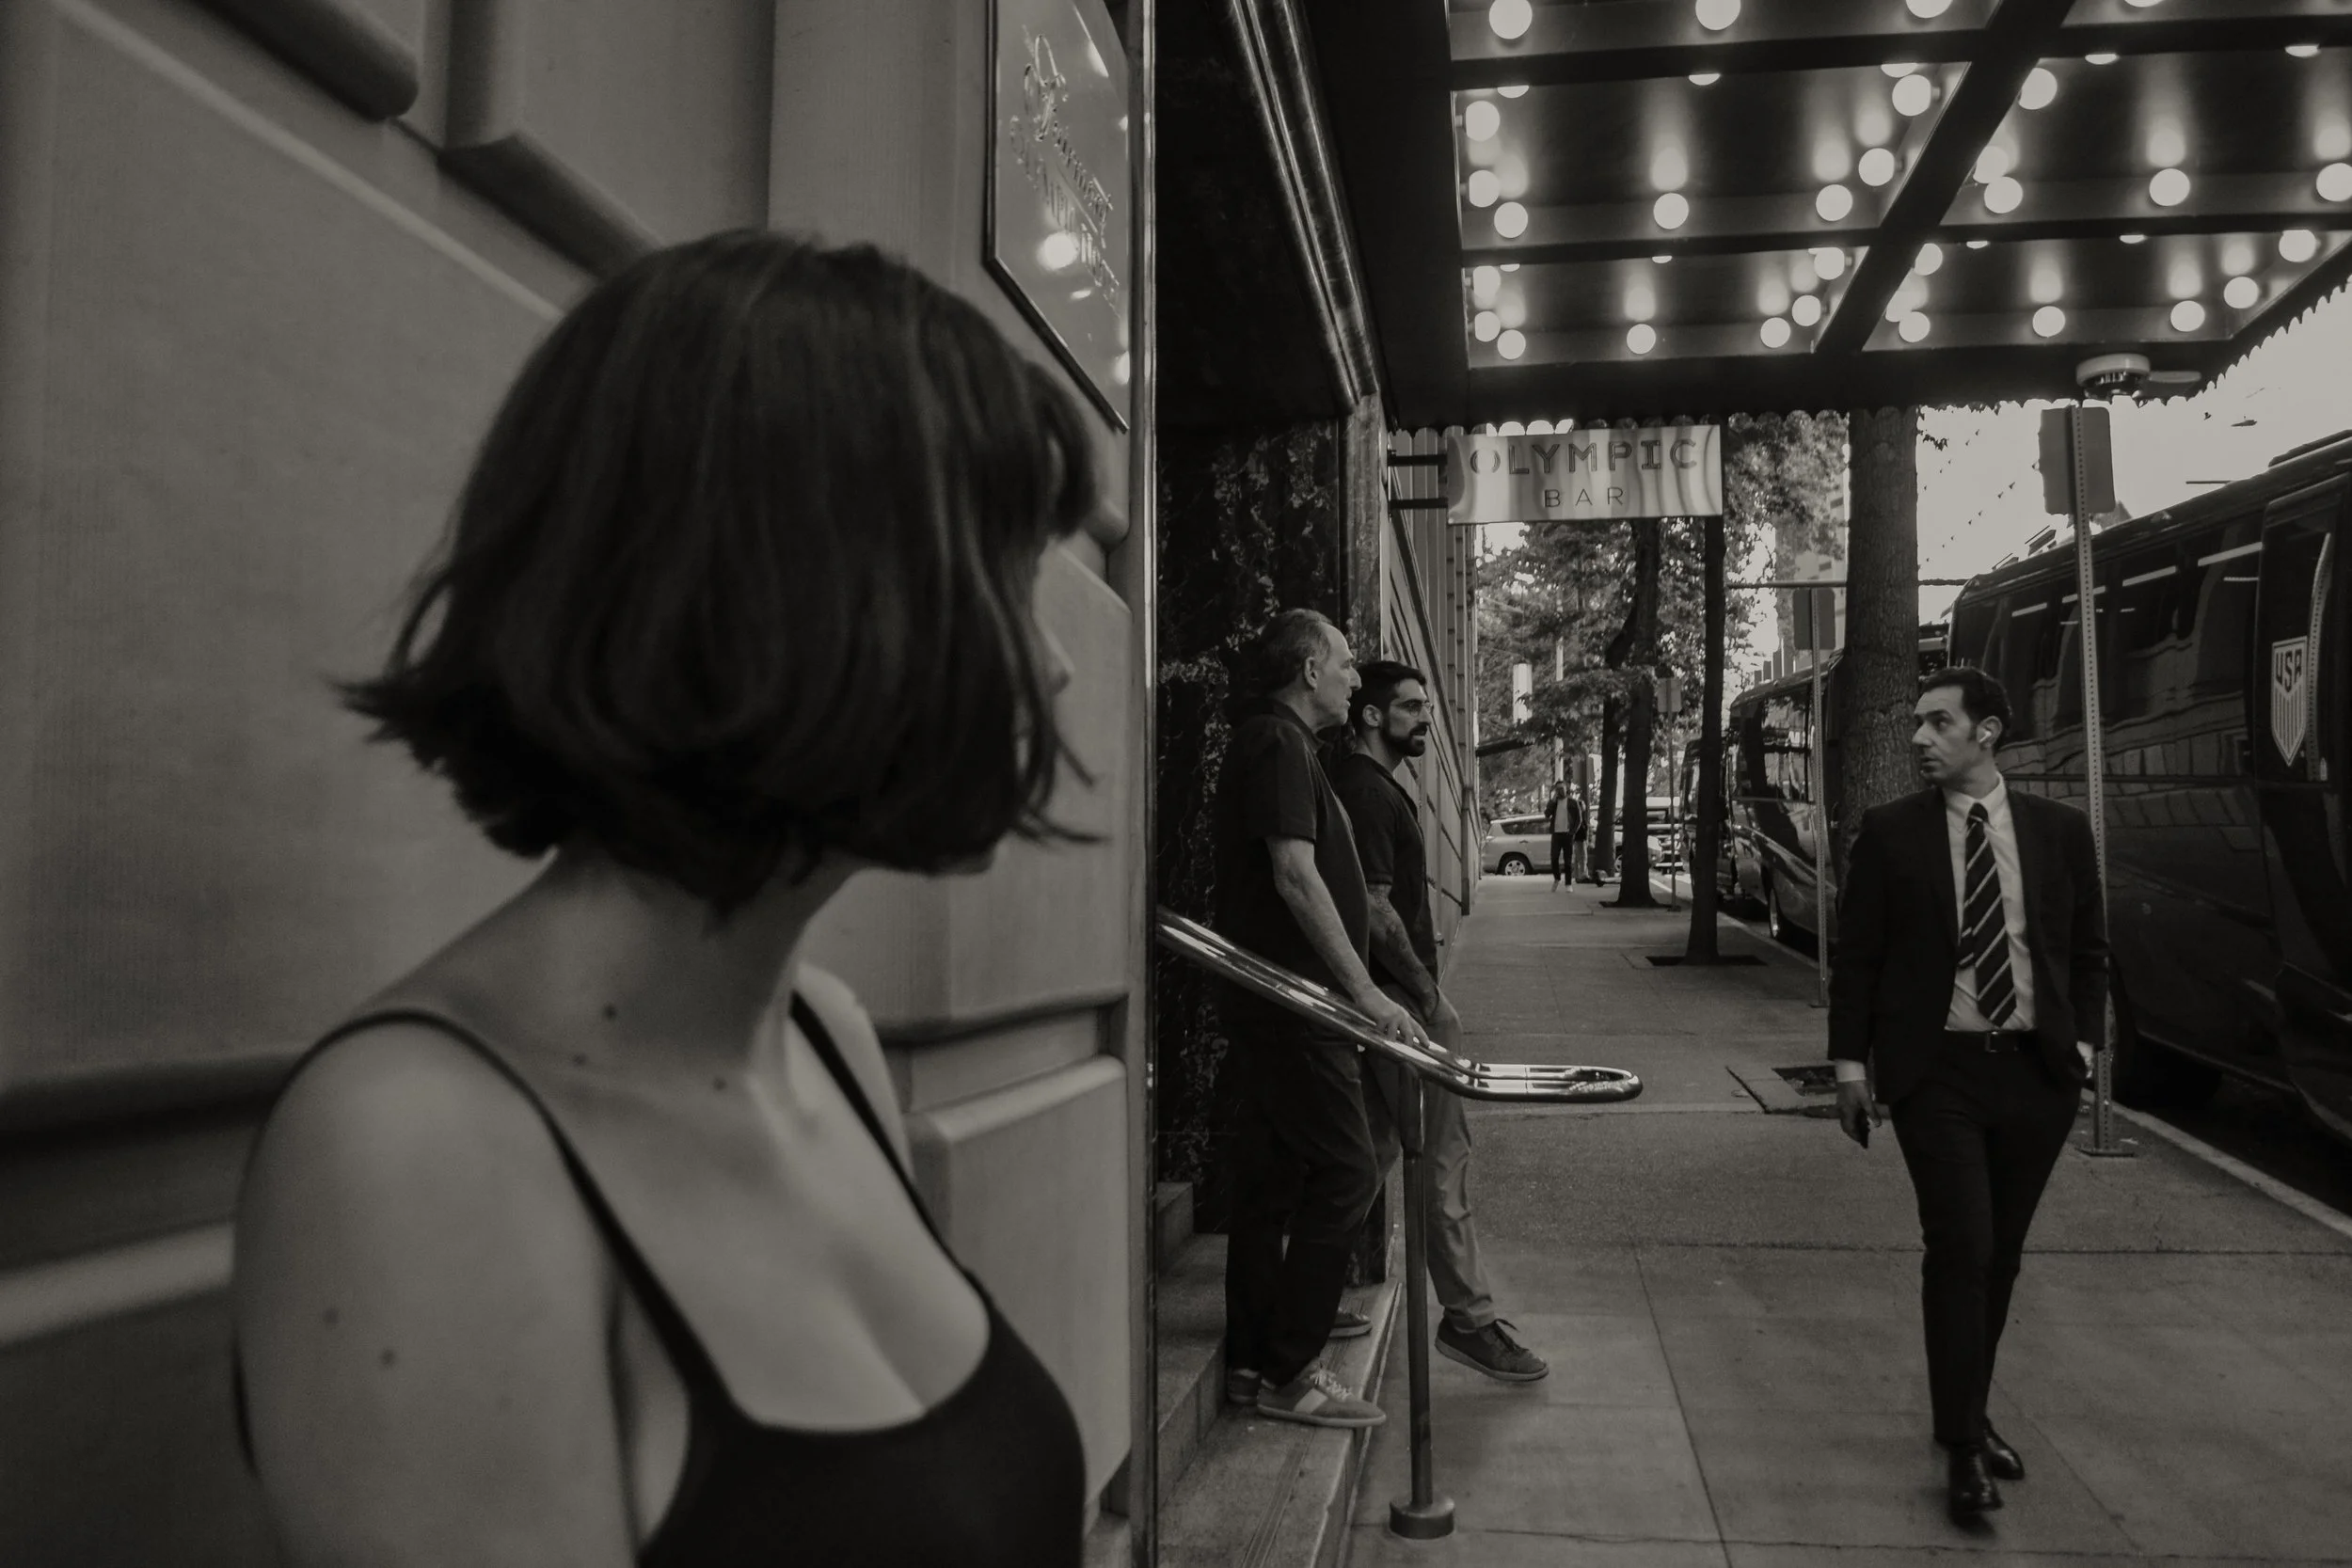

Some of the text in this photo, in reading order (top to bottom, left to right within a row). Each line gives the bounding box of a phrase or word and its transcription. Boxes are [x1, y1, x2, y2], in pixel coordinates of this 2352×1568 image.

[1470, 439, 1697, 474] OLYMPIC
[1544, 486, 1625, 508] BAR
[2275, 649, 2302, 692] USA
